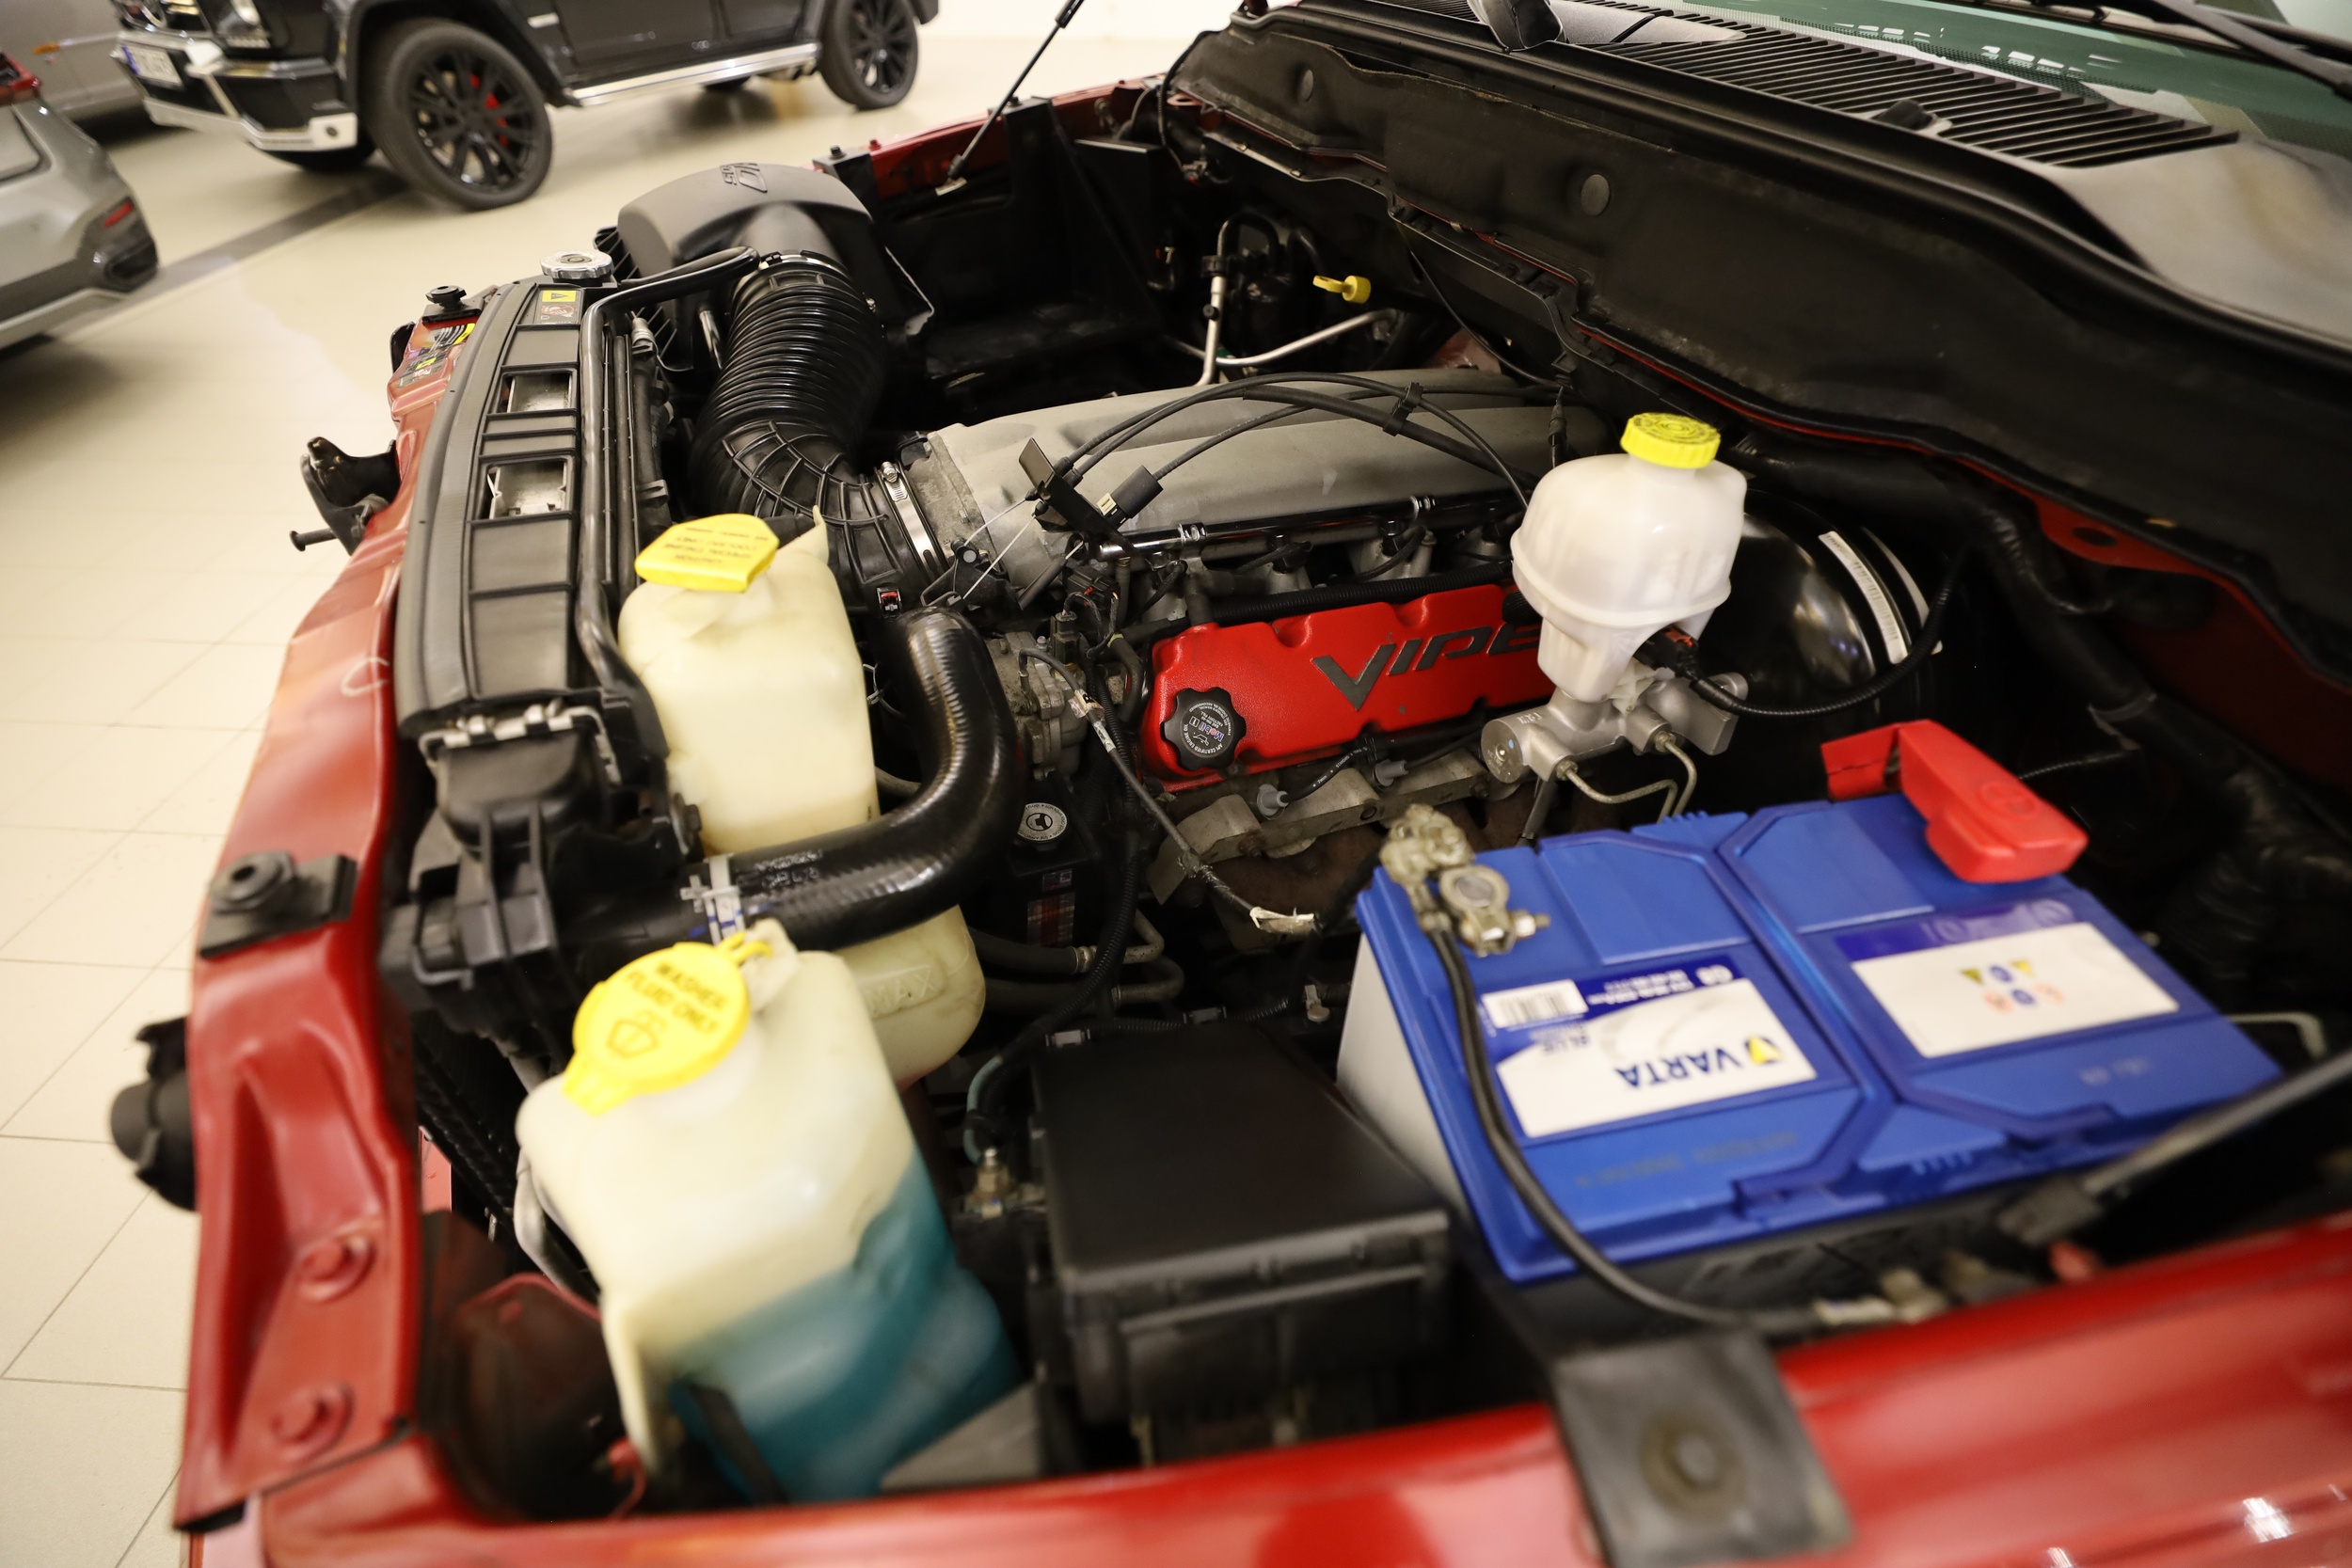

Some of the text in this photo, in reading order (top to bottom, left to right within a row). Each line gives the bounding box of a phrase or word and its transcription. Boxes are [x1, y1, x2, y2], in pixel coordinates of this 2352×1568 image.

[1184, 732, 1195, 749] ENGINE
[1198, 722, 1225, 742] Mobil
[1194, 745, 1216, 754] CERTIFIED
[656, 961, 726, 1008] WASHER
[625, 971, 718, 1035] FLUID ONLY
[1614, 1048, 1742, 1087] VARTA
